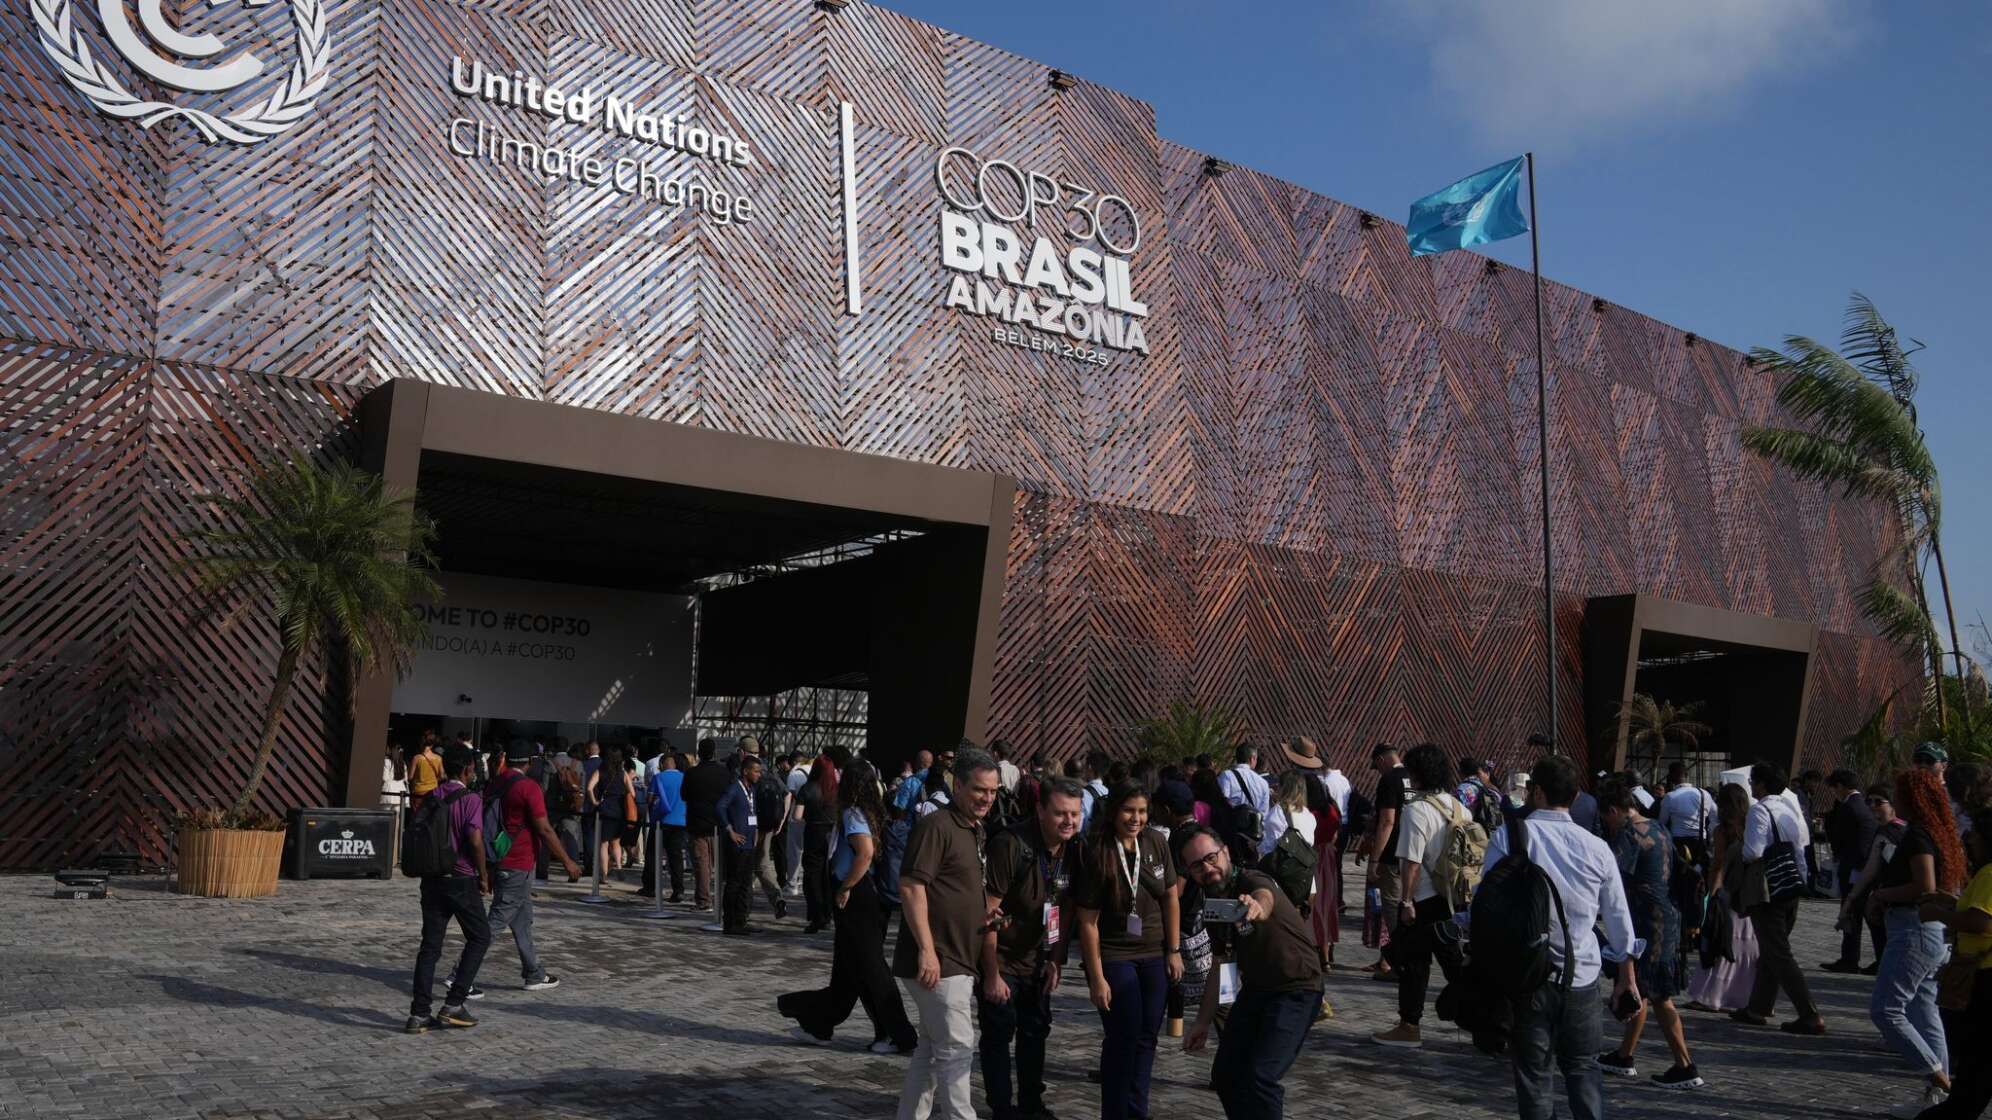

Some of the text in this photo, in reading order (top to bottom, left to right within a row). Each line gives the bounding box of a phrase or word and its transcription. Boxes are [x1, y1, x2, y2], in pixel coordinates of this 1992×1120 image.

[452, 56, 750, 165] United Nations
[450, 118, 752, 224] Climate Change
[937, 147, 1140, 254] COP30
[941, 210, 1148, 317] BRASIL
[946, 275, 1150, 355] AMAZÔNIA
[994, 328, 1109, 366] BELÉM 2025
[466, 609, 498, 628] TO
[503, 612, 590, 637] #COP30
[490, 641, 503, 656] A
[508, 642, 576, 661] #COP30
[318, 839, 376, 855] CERPA
